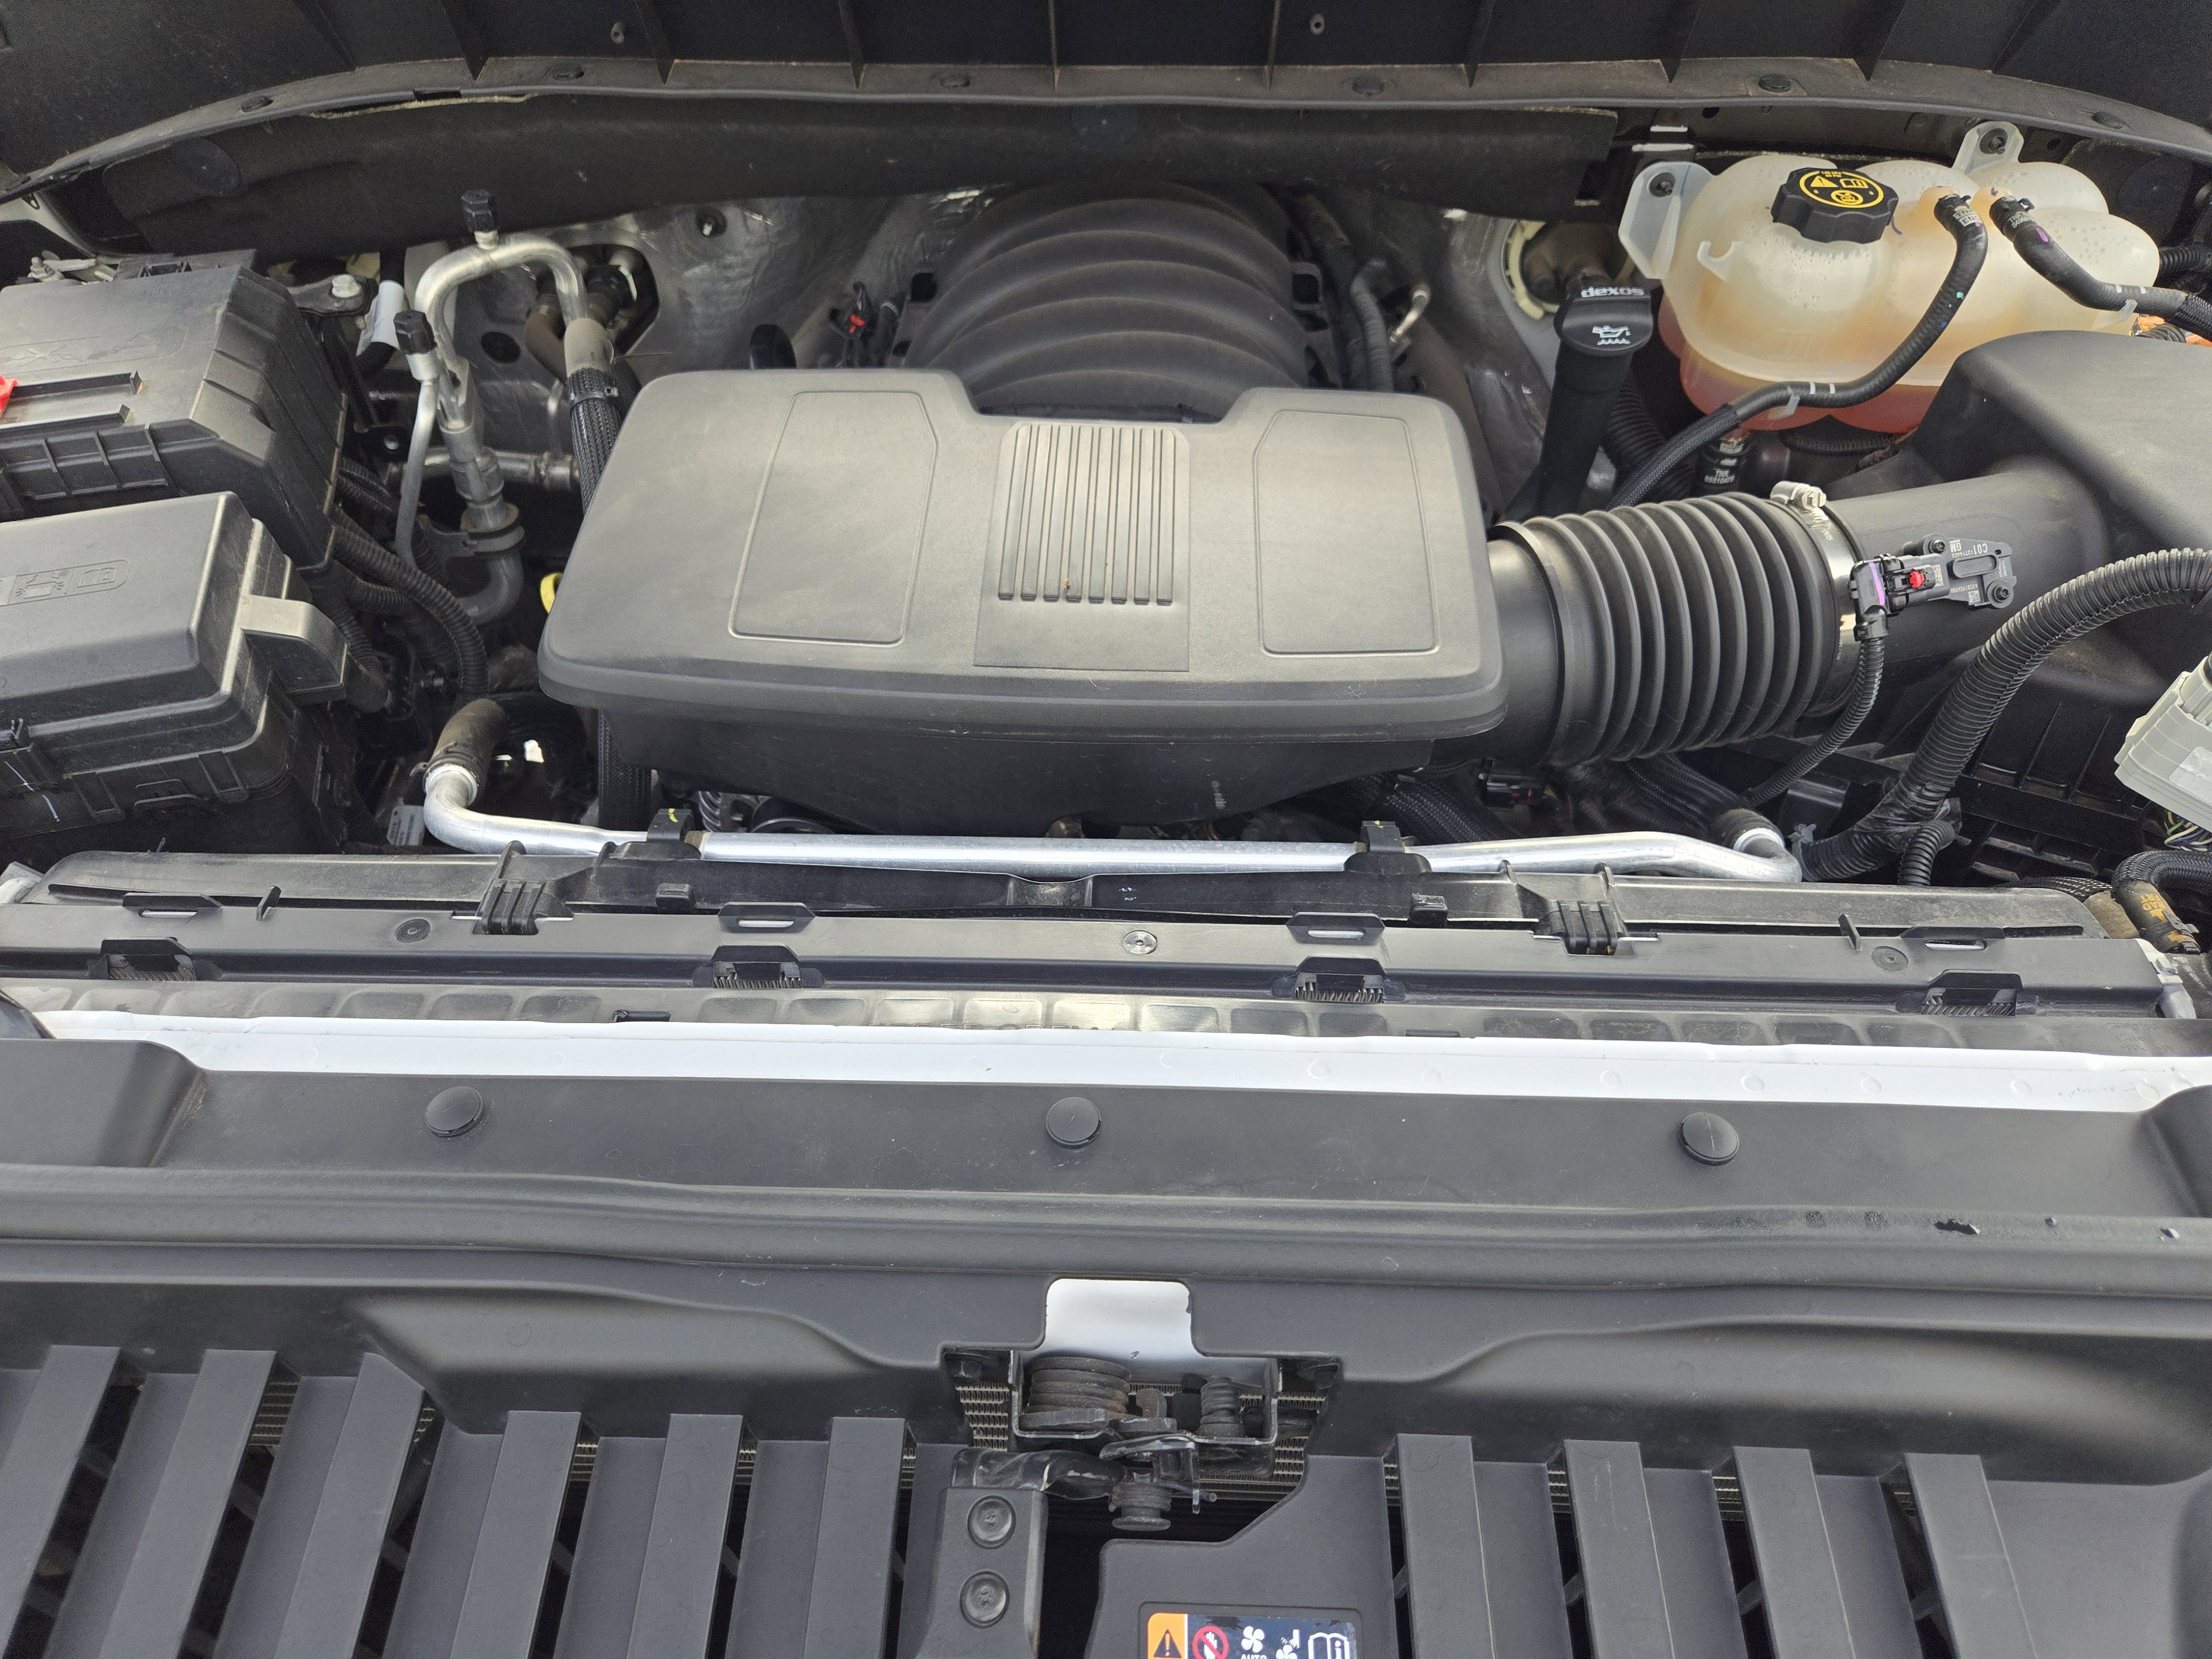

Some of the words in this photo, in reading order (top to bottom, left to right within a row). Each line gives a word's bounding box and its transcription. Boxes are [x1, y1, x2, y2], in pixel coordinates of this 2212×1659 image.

[1581, 286, 1645, 298] dexos
[1949, 541, 1962, 553] GM
[1973, 542, 1989, 555] C01
